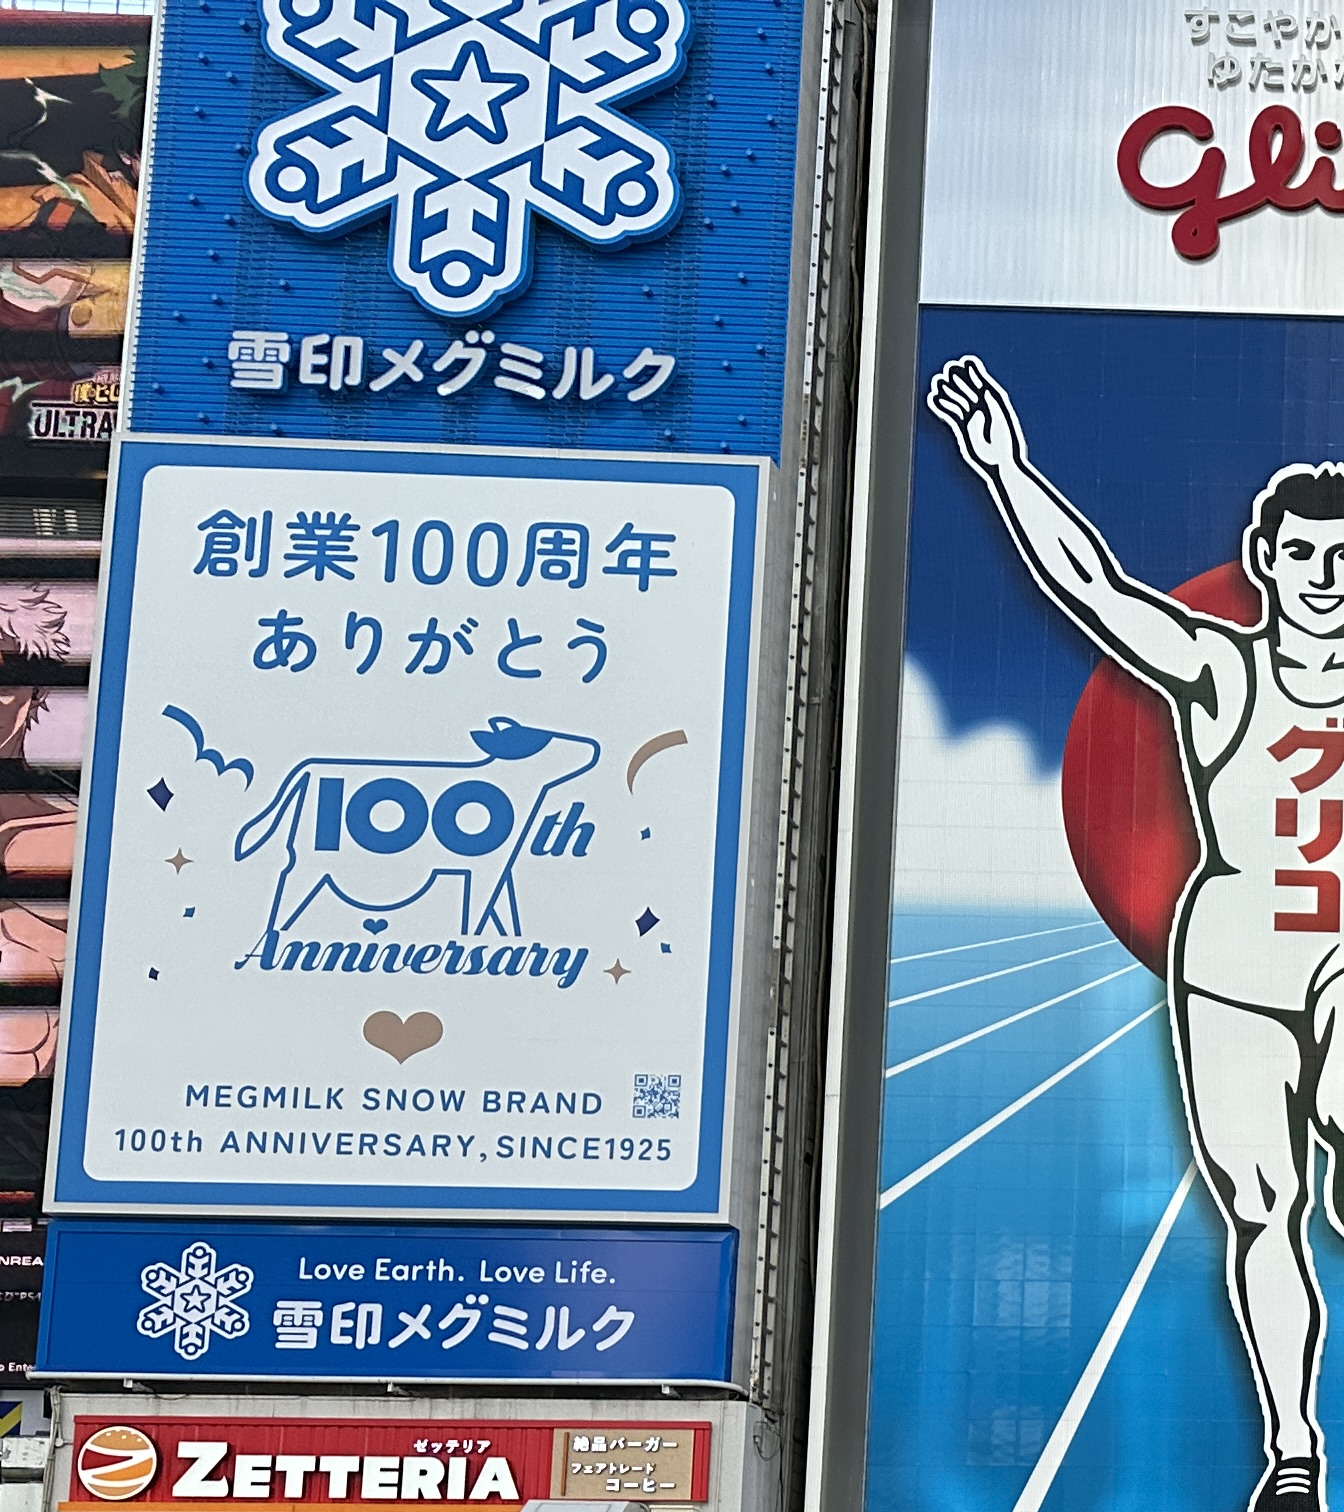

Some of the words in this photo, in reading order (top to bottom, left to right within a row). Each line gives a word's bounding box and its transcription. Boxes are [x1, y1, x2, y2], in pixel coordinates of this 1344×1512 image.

[228, 331, 679, 402] 雪印メグミルク
[193, 509, 679, 593] 創業100周年
[252, 608, 611, 684] ありがとう
[314, 777, 596, 857] 100th
[234, 930, 589, 989] Anniversary
[185, 1084, 345, 1111] MEGMILK
[362, 1087, 465, 1114] SNOW
[481, 1089, 603, 1116] BRAND
[114, 1128, 203, 1155] 100th
[299, 1257, 365, 1282] Love
[374, 1258, 466, 1284] Earth.
[480, 1260, 546, 1284] Love
[555, 1260, 617, 1285] Life.
[273, 1294, 636, 1352] 雪印メグミルク
[413, 1438, 491, 1454] ゼッテリア
[573, 1435, 678, 1453] 絶品バーガー
[172, 1441, 520, 1500] ZETTERIA
[571, 1462, 655, 1475] フェアトレード
[605, 1477, 676, 1493] コーヒー
